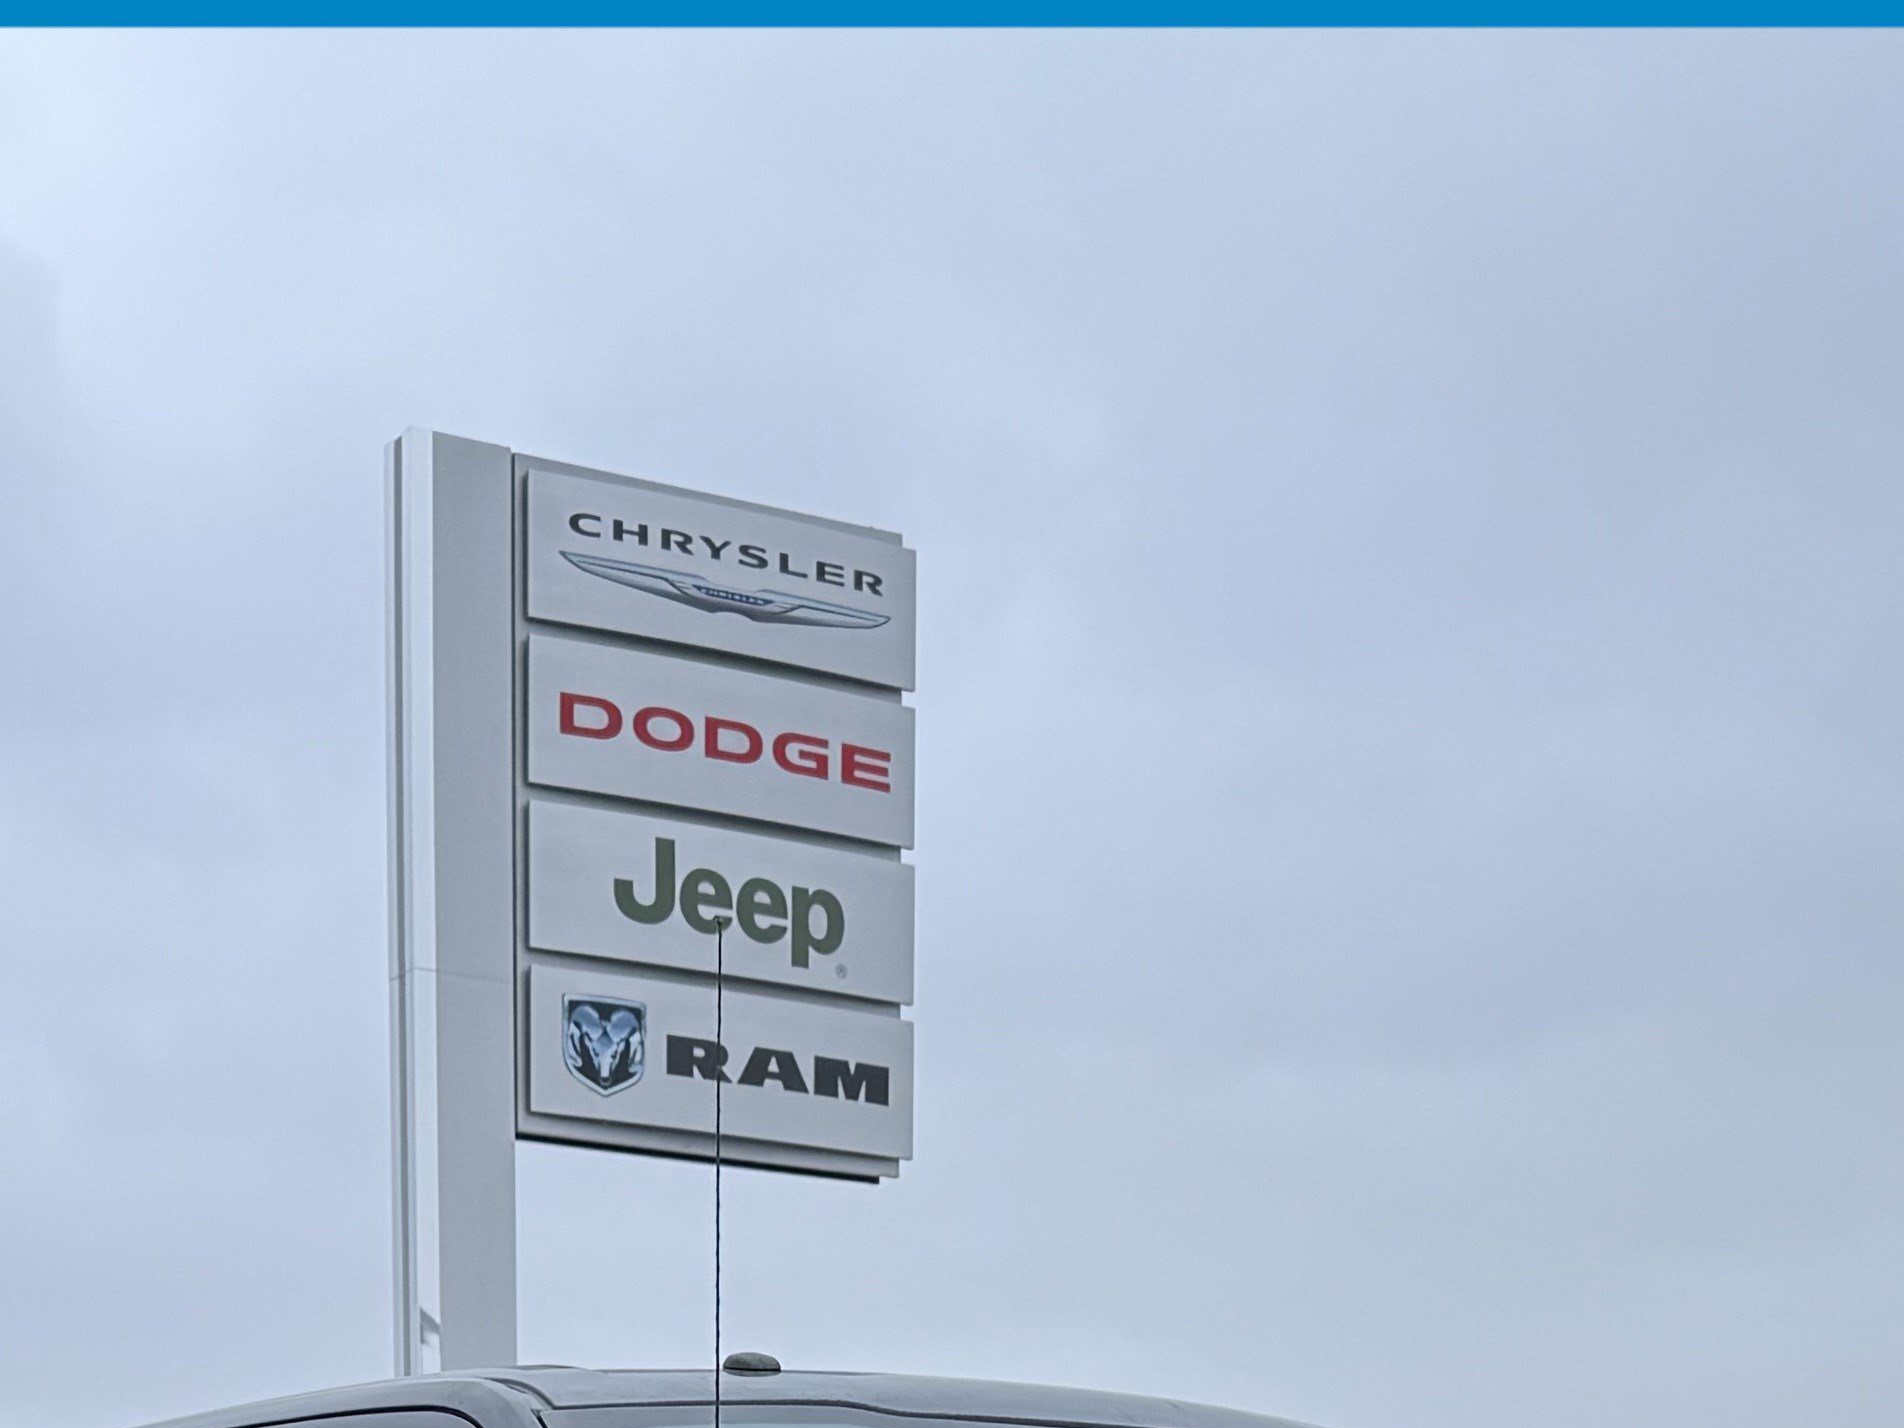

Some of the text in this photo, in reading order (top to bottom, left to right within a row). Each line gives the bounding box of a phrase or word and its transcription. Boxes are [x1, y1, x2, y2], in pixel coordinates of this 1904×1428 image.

[568, 511, 884, 598] CHRYSLER
[559, 692, 892, 793] DODGE
[612, 836, 846, 969] Jeep
[666, 1033, 890, 1107] RAM
